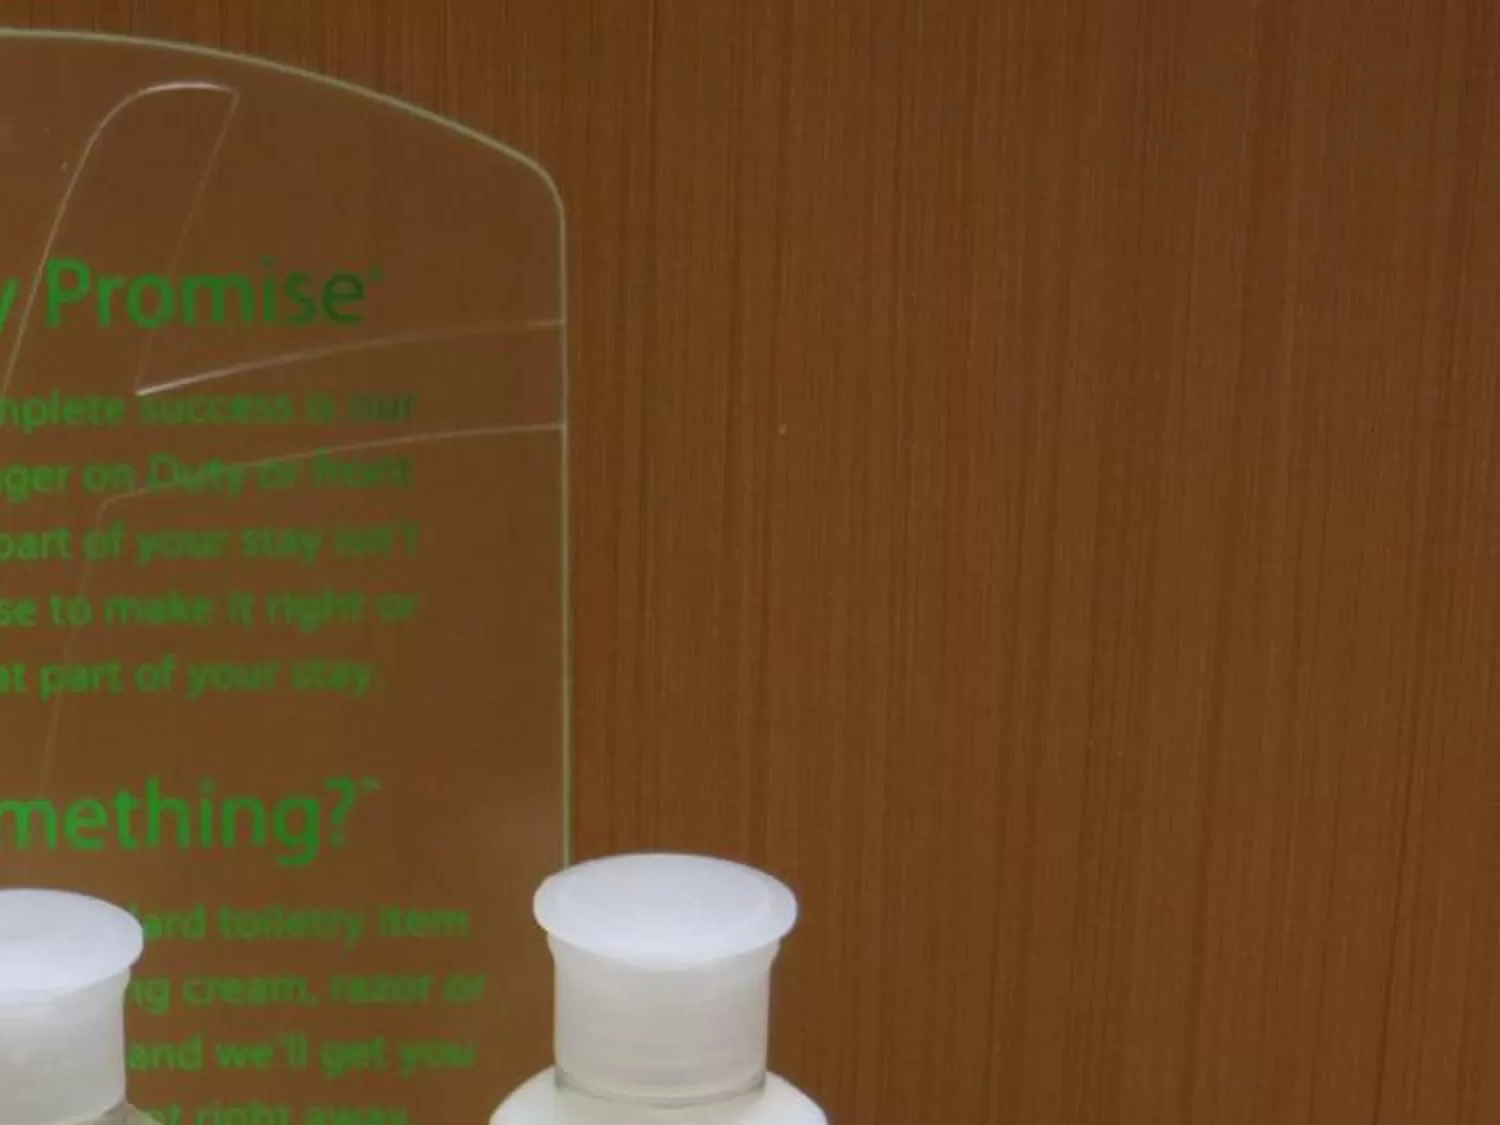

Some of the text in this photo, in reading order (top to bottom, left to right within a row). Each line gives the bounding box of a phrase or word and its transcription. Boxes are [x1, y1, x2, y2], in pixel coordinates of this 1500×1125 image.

[140, 394, 293, 424] success
[83, 464, 135, 493] on
[148, 453, 245, 498] Duty
[84, 519, 126, 561] of
[135, 529, 229, 567] your
[242, 526, 324, 567] stay
[50, 593, 93, 627] to
[105, 589, 213, 627] make
[228, 592, 256, 627] it
[266, 588, 364, 632] right
[376, 593, 419, 624] or
[39, 659, 123, 701] part
[134, 652, 177, 692] of
[187, 662, 281, 700] your
[137, 903, 206, 940] ard
[217, 904, 365, 949] toiletry
[379, 905, 470, 939] item
[329, 974, 434, 1006] razor
[444, 974, 488, 1005] or
[128, 1035, 204, 1071] and
[216, 1033, 308, 1070] we'll
[320, 1038, 387, 1078] get
[400, 1040, 478, 1077] you
